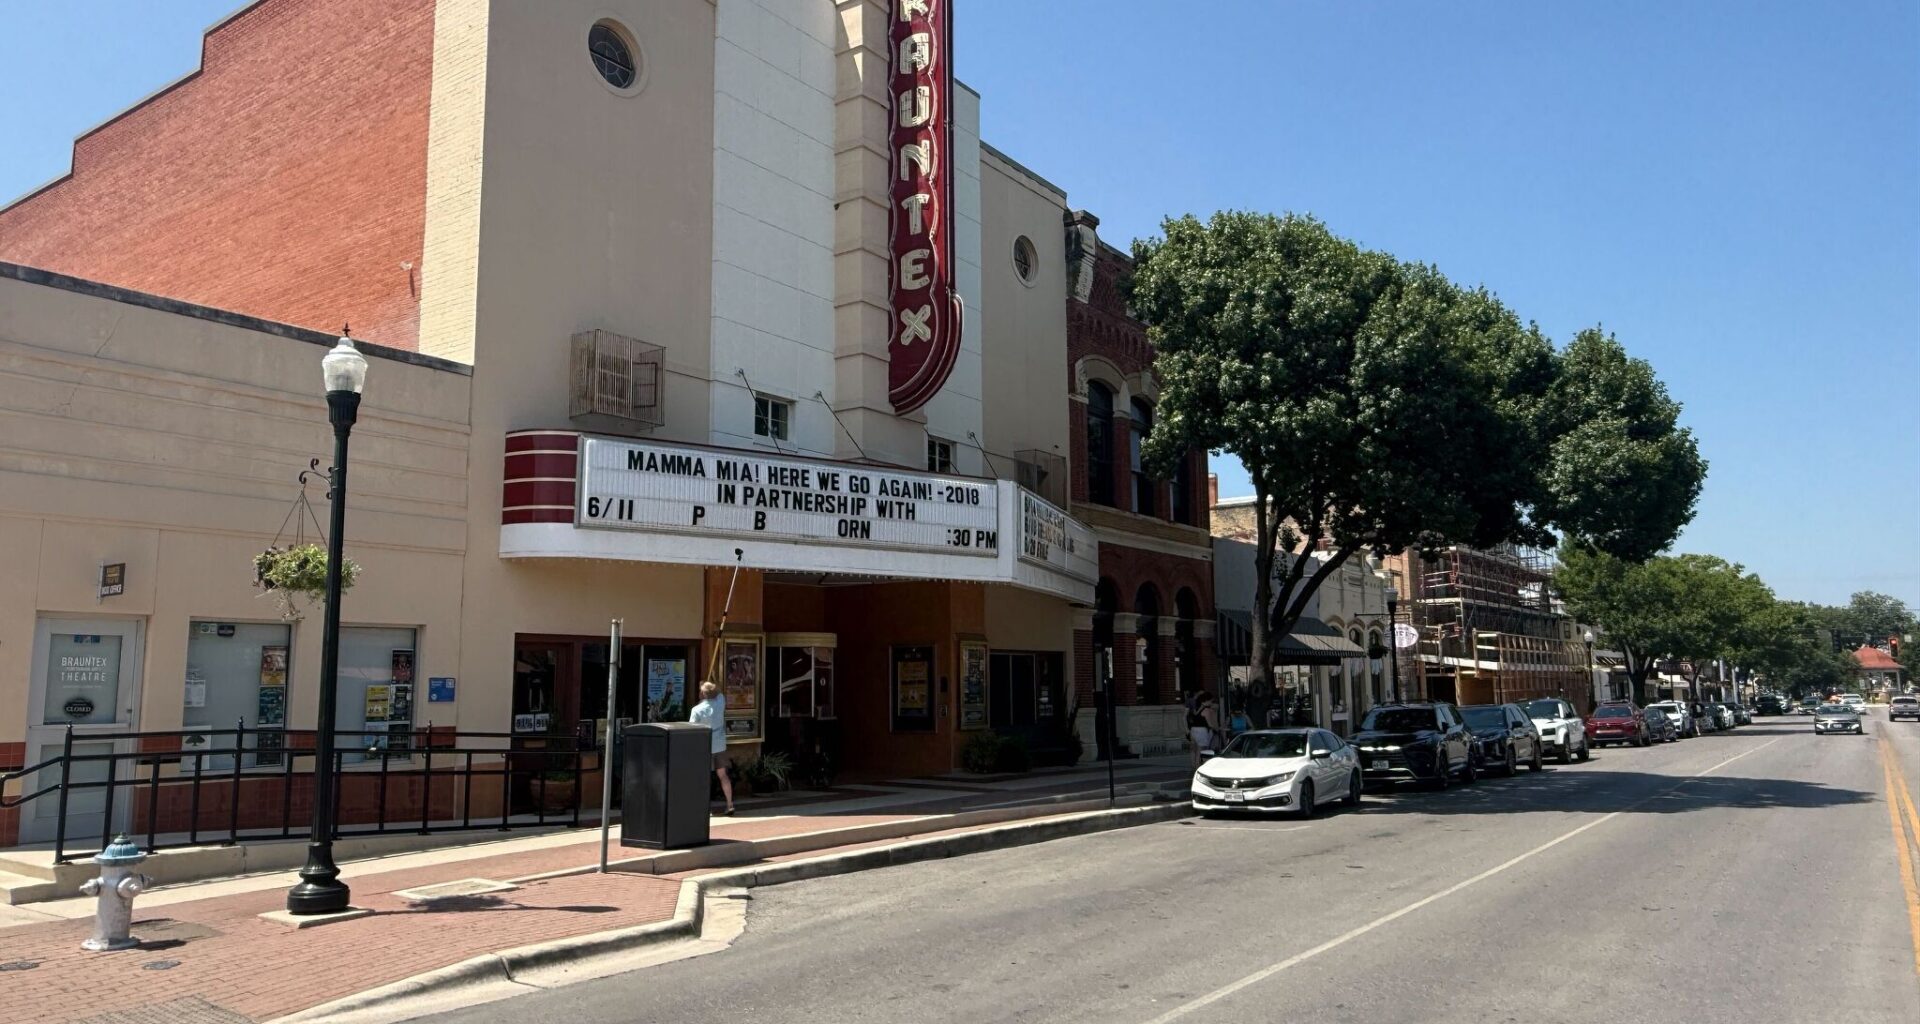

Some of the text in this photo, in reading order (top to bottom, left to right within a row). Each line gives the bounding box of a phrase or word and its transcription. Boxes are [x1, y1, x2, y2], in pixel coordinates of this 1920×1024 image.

[628, 450, 980, 505] MAMMA MIA! HERE WE GO AGAIN! -2018
[717, 484, 916, 521] IN PARTNERSHIP WITH
[587, 496, 997, 549] 6/11 P B ORN :30 PM
[61, 656, 107, 667] BRAUNTEX
[61, 672, 107, 682] THEATRE
